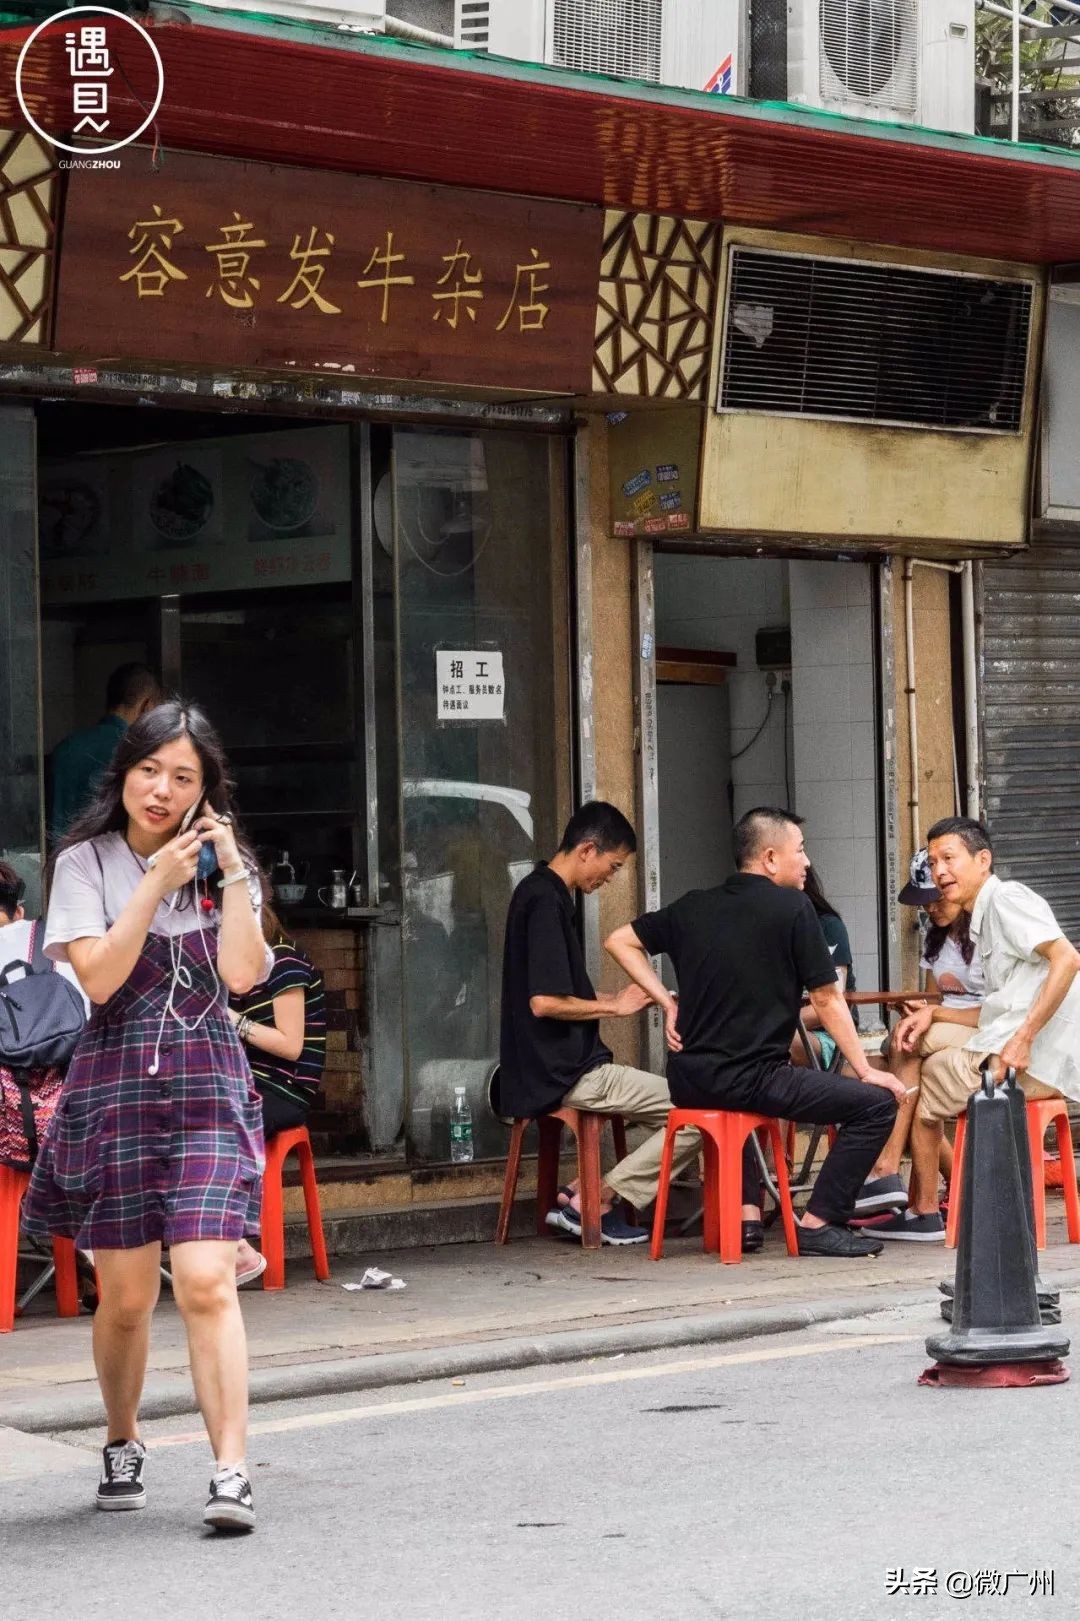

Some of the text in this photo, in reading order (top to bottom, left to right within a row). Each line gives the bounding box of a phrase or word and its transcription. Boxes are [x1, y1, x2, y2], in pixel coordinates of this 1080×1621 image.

[119, 204, 551, 333] 容意发牛杂店
[450, 660, 489, 678] 招工
